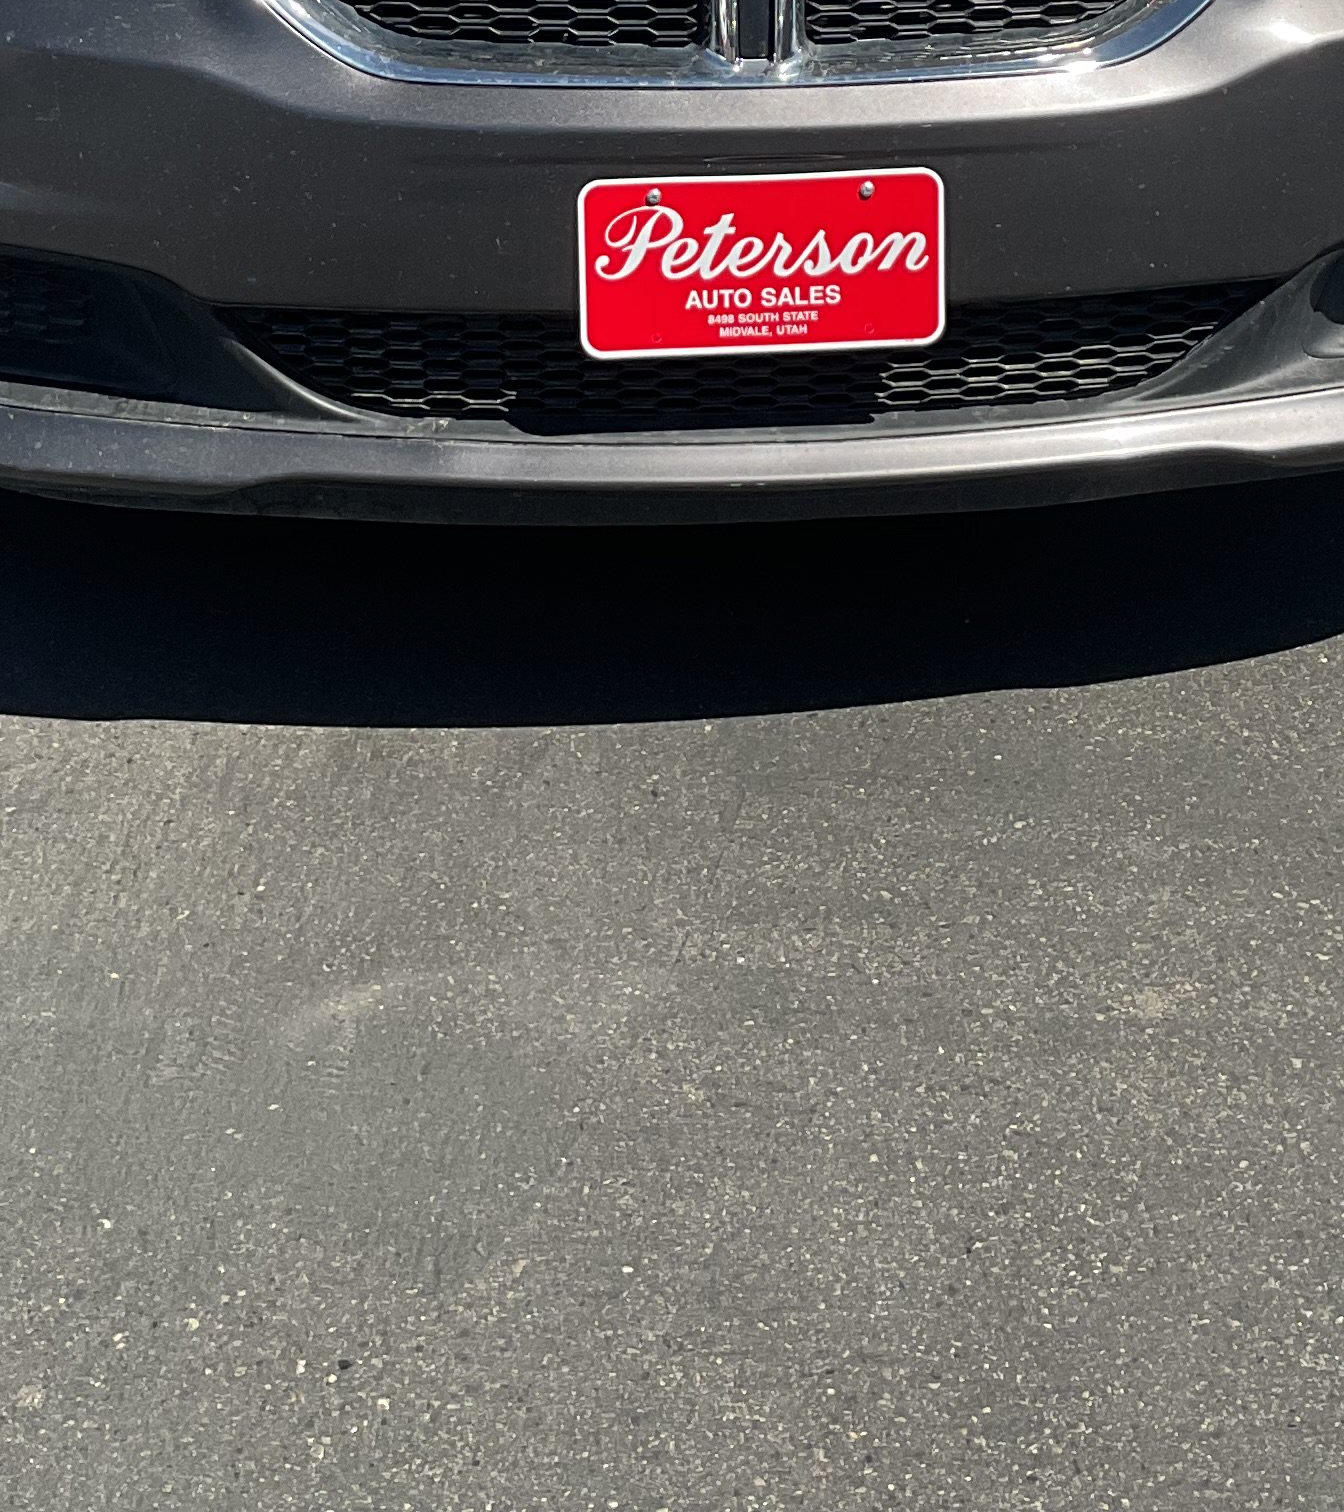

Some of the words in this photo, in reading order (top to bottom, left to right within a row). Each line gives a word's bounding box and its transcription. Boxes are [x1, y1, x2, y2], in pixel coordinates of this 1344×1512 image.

[594, 205, 930, 281] Peterson
[684, 289, 753, 310] AUTO
[760, 284, 841, 307] SALES
[707, 312, 735, 325] 8498
[738, 310, 780, 324] SOUTH
[783, 309, 819, 323] STATE
[719, 325, 774, 338] MIDVALE,
[776, 324, 808, 336] UTAH
